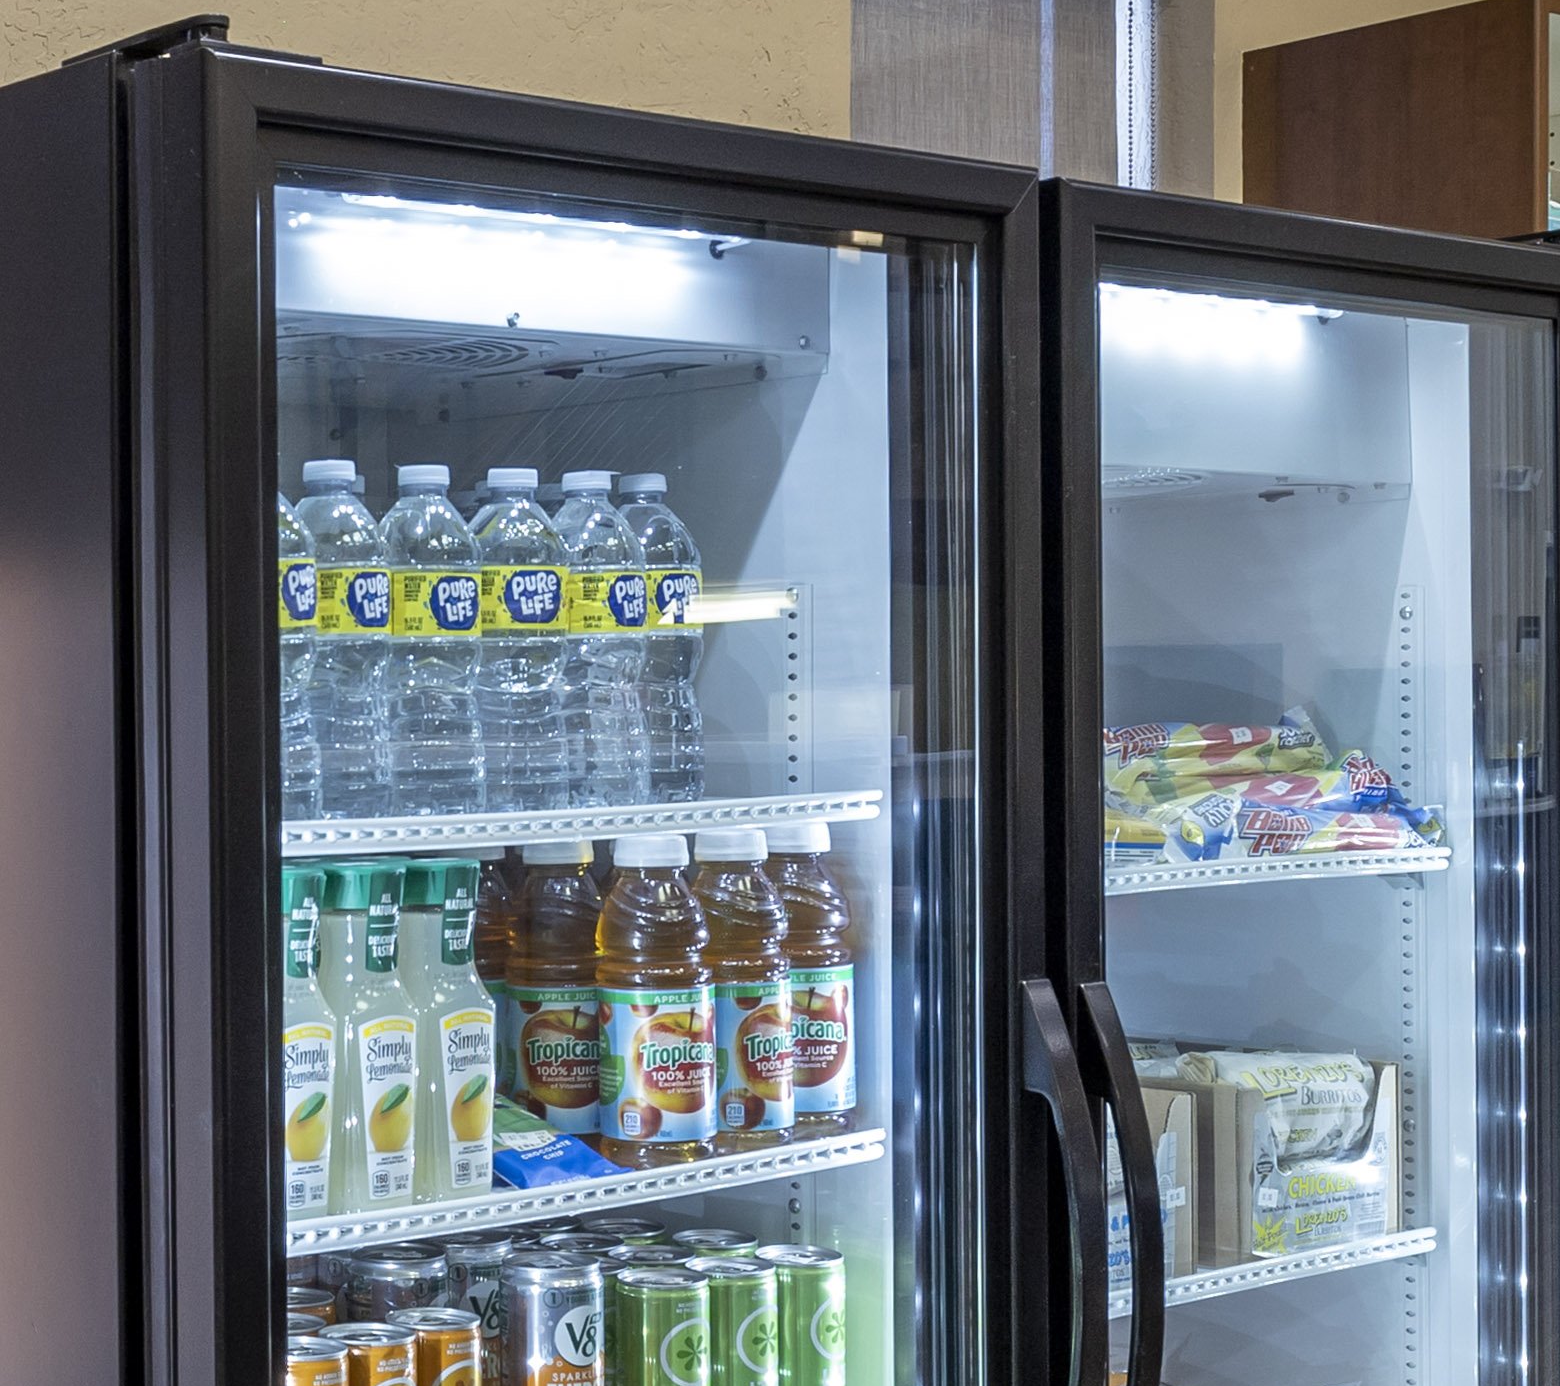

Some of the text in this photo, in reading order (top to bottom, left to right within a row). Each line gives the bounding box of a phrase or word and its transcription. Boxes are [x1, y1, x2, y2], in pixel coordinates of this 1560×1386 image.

[456, 888, 467, 897] ALL
[381, 894, 391, 903] ALL
[806, 973, 837, 982] JUICE
[537, 992, 568, 1001] APPLE
[654, 994, 686, 1004] APPLE
[448, 1027, 490, 1054] Simply
[367, 1036, 412, 1062] Simply
[641, 1035, 714, 1068] Tropicana
[803, 1044, 838, 1055] JUICE
[286, 1043, 328, 1070] Simply
[448, 1054, 491, 1075] Lemonade
[366, 1062, 412, 1083] Lemonade
[536, 1066, 568, 1076] 100%
[652, 1071, 685, 1081] 100%
[1301, 1086, 1362, 1105] BURRITOS
[458, 1163, 470, 1174] 160
[375, 1174, 389, 1185] 160
[1289, 1173, 1356, 1199] CHICKEN
[565, 1321, 599, 1358] V8
